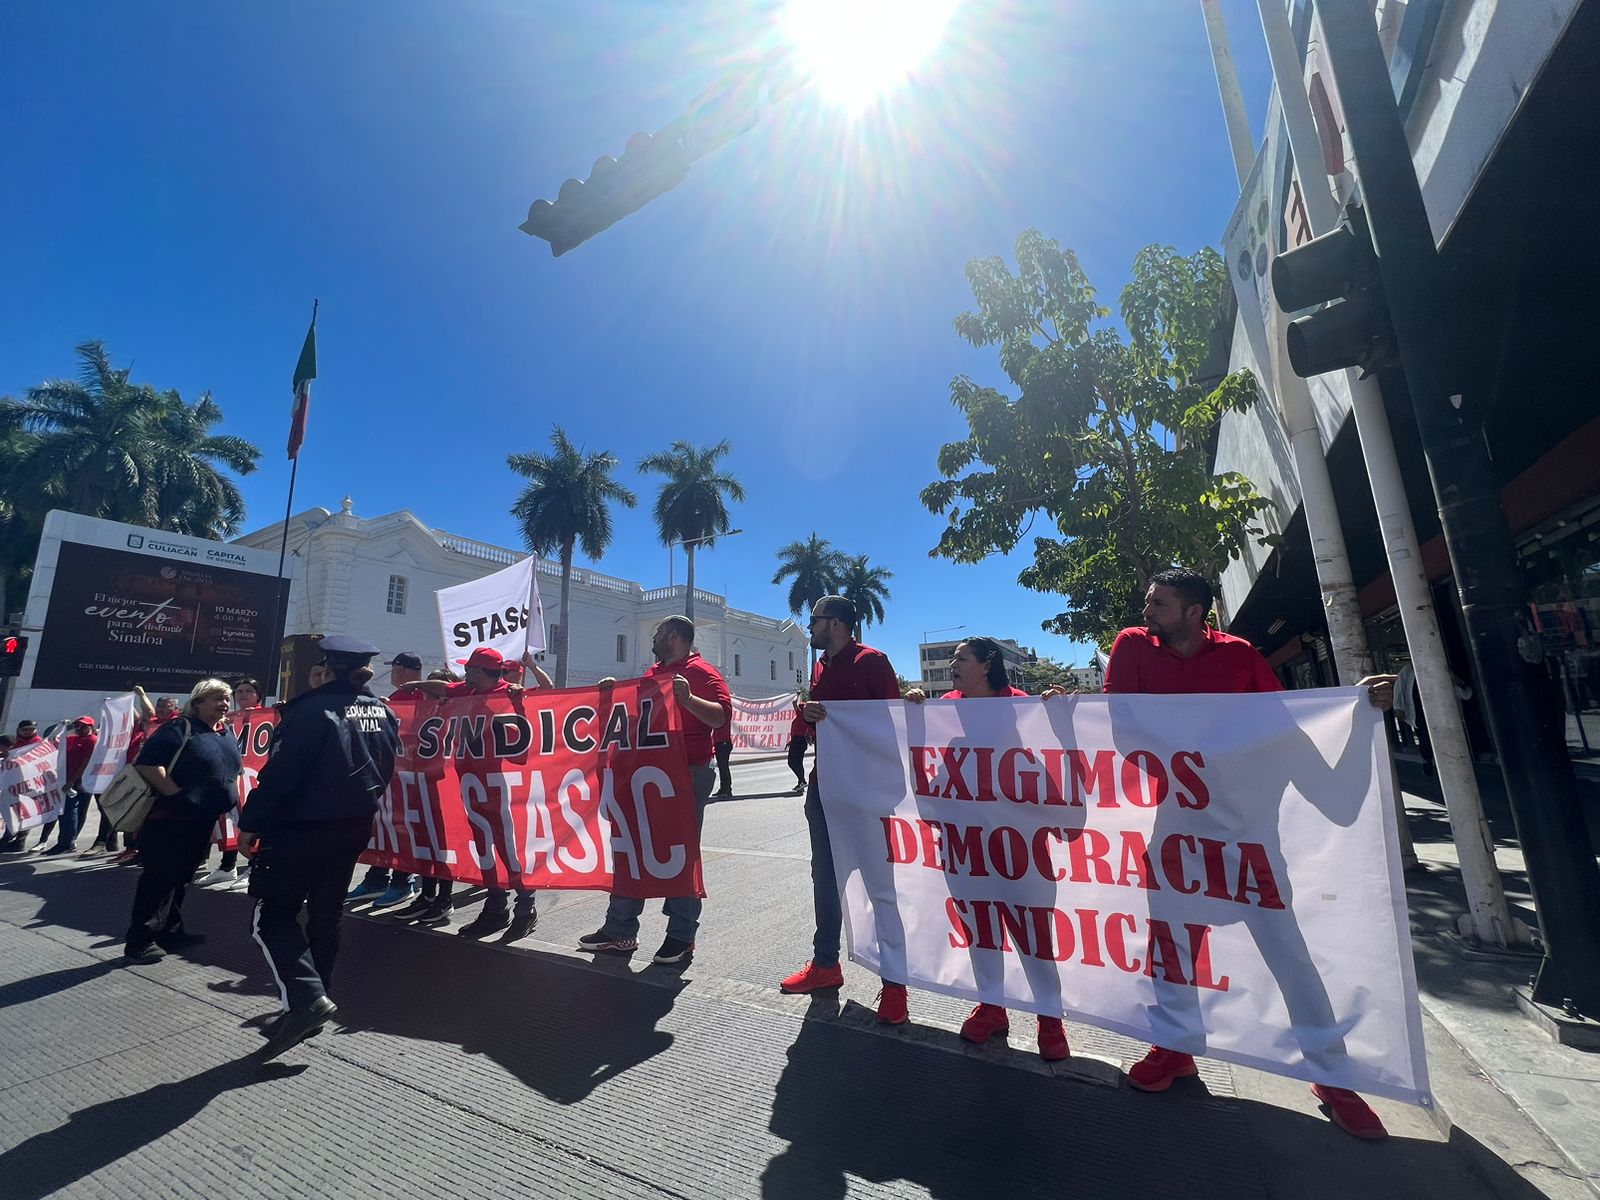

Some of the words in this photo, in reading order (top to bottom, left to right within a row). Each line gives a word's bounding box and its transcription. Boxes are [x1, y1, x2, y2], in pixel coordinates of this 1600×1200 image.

[207, 549, 247, 562] CAPITAL
[94, 592, 106, 602] El
[107, 596, 137, 606] mejor
[215, 605, 225, 613] 10
[226, 607, 258, 617] MARZO
[84, 597, 182, 629] evento
[107, 620, 133, 629] para
[108, 629, 163, 646] Sinaloa
[453, 603, 529, 648] STAS
[78, 662, 115, 670] CULTURA
[360, 719, 382, 732] VIAL
[416, 697, 671, 760] SINDICAL
[909, 746, 1211, 811] EXIGIMOS
[397, 770, 457, 865] EL
[460, 765, 687, 881] STASAC
[880, 816, 1287, 911] DEMOCRACIA
[947, 896, 1231, 992] SINDICAL
